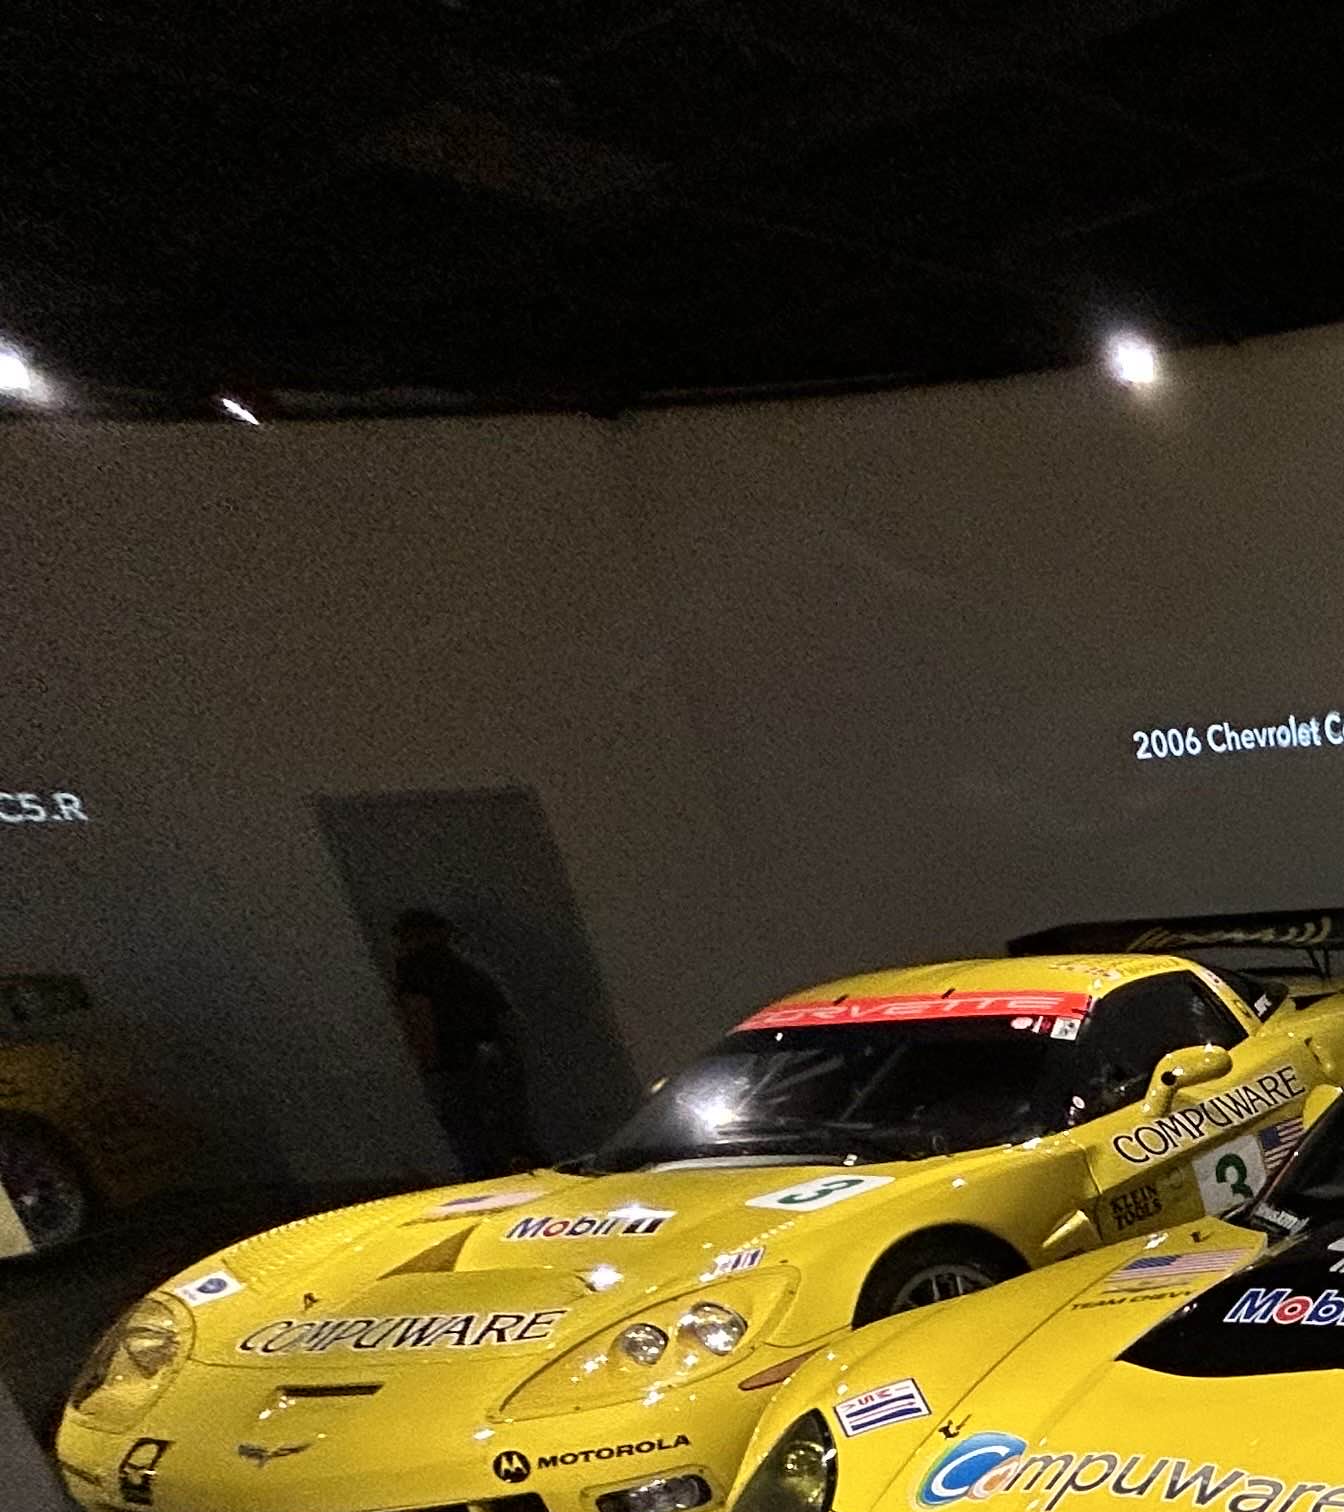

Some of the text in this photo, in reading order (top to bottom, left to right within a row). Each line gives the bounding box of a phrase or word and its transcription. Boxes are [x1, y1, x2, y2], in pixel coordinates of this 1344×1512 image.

[1132, 727, 1202, 760] 2006
[1206, 714, 1322, 753] Chevrolet
[1112, 1065, 1306, 1164] COMPUWARE
[239, 1308, 569, 1355] COMPUWARE
[536, 1433, 692, 1470] MOTOROLA
